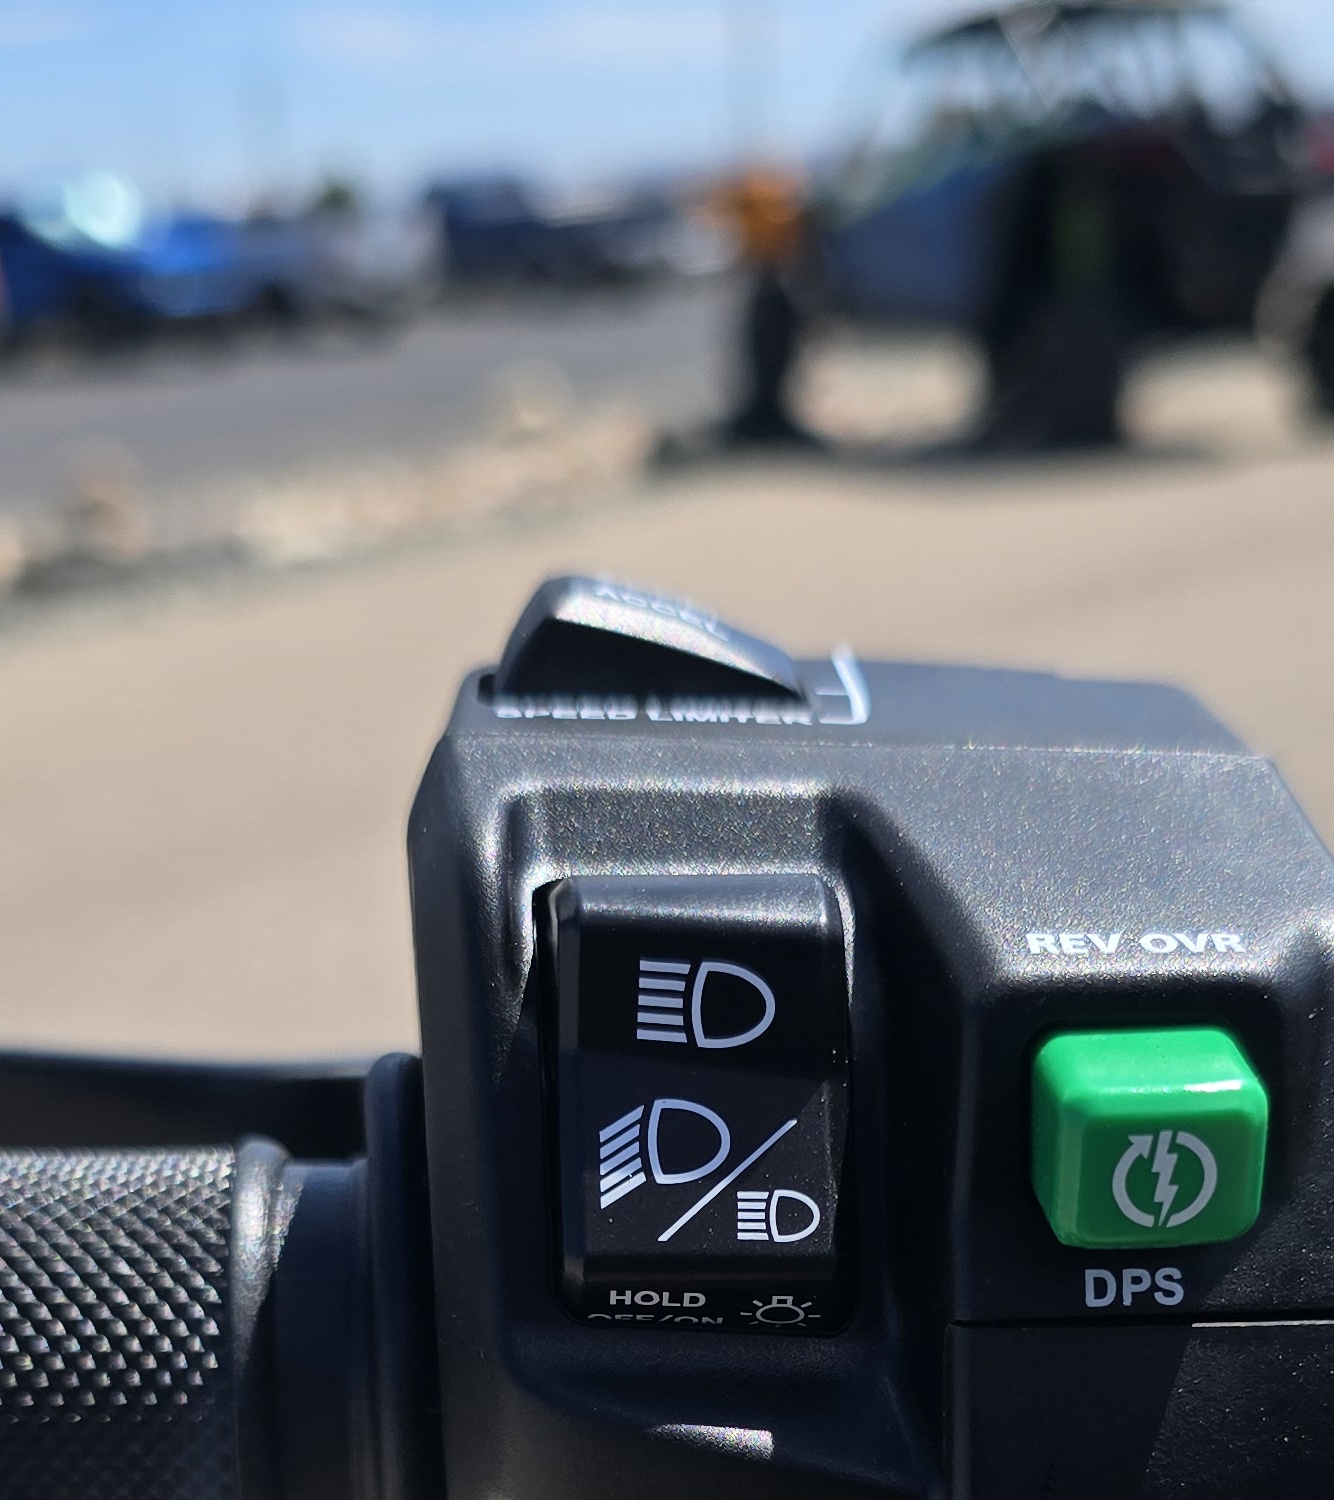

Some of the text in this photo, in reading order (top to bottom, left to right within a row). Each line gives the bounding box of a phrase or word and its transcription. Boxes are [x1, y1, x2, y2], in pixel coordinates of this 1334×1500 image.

[495, 694, 813, 726] SPEED LIMITER
[1025, 932, 1246, 955] REV OVR
[609, 1289, 707, 1308] HOLD
[1084, 1267, 1185, 1308] DPS
